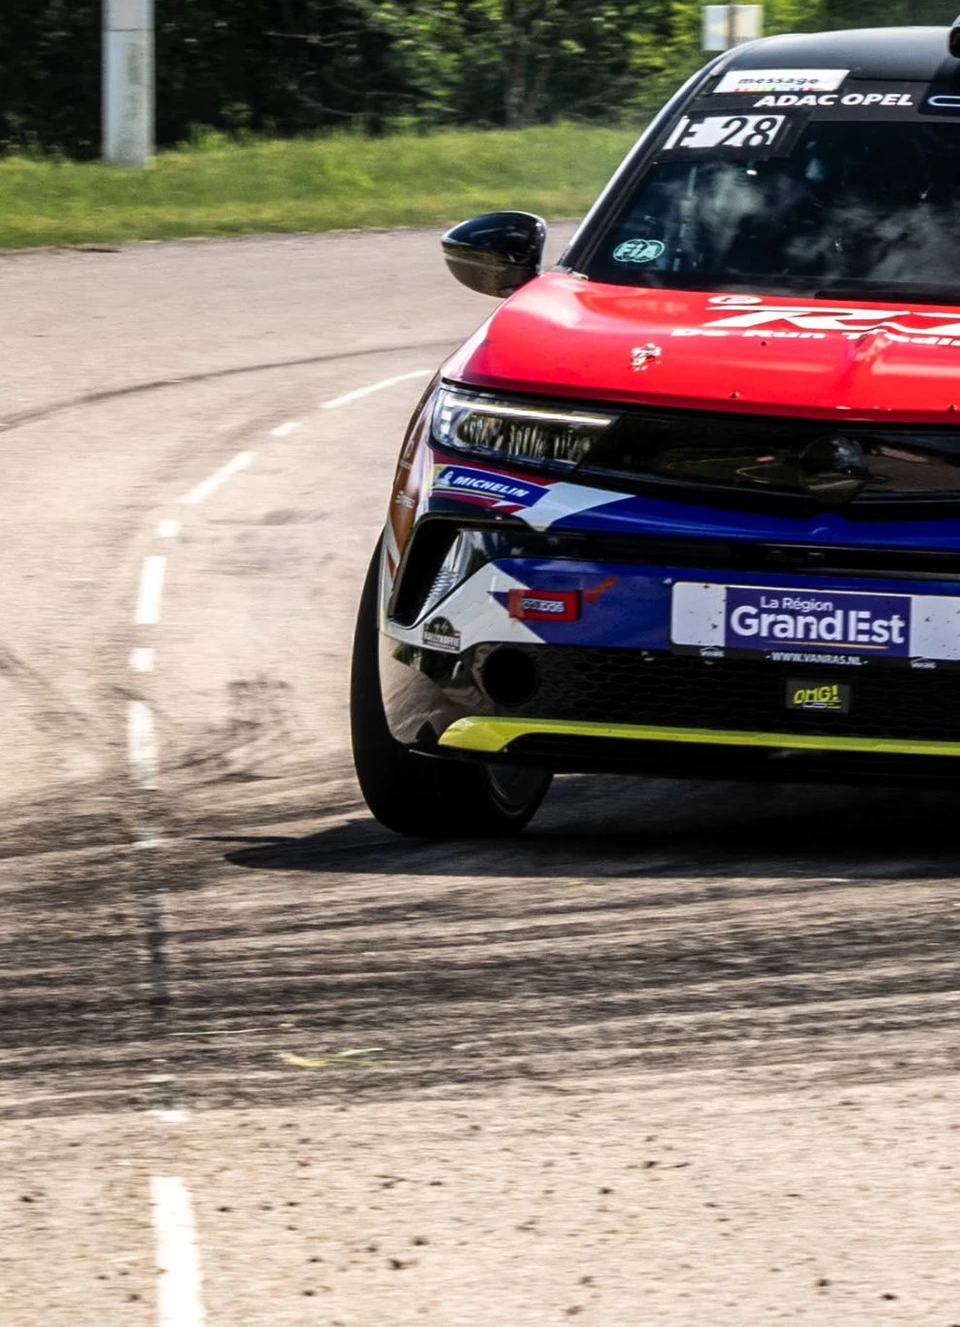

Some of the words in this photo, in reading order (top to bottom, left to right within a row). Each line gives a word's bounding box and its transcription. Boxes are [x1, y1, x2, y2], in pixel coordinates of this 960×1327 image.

[737, 76, 821, 86] message
[753, 94, 838, 108] ADAC
[840, 93, 914, 107] OPEL
[714, 116, 779, 149] 28
[615, 242, 661, 260] FIA
[670, 328, 731, 337] De
[742, 329, 826, 340] Run
[453, 476, 530, 498] MICHELIN
[760, 596, 779, 609] La
[783, 597, 834, 614] Région
[793, 684, 839, 705] OMG!
